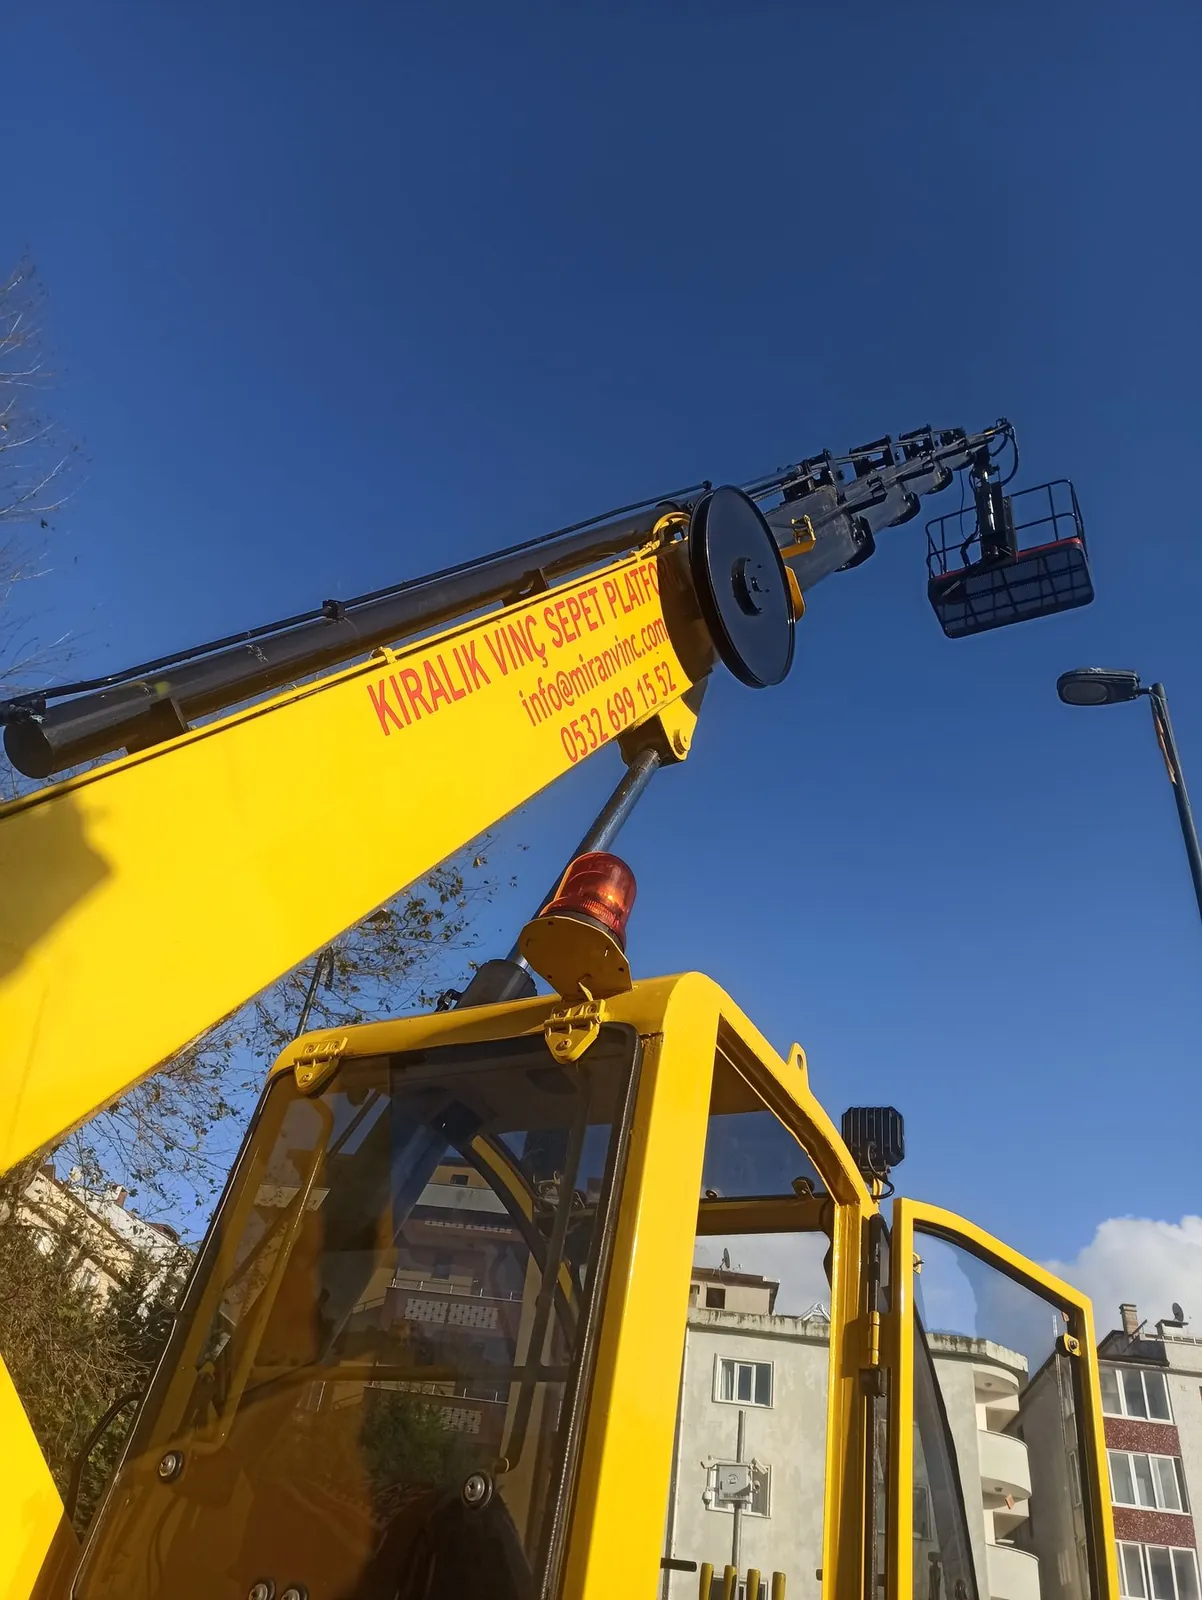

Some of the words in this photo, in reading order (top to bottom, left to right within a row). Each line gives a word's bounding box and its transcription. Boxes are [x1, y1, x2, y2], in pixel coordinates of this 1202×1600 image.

[366, 639, 492, 737] KIRALIK
[543, 586, 605, 649] SEPET
[518, 617, 669, 727] info@miranvinc.com
[560, 707, 610, 763] 0532
[606, 686, 636, 732] 699
[636, 672, 658, 710] 15
[653, 661, 677, 697] 52
